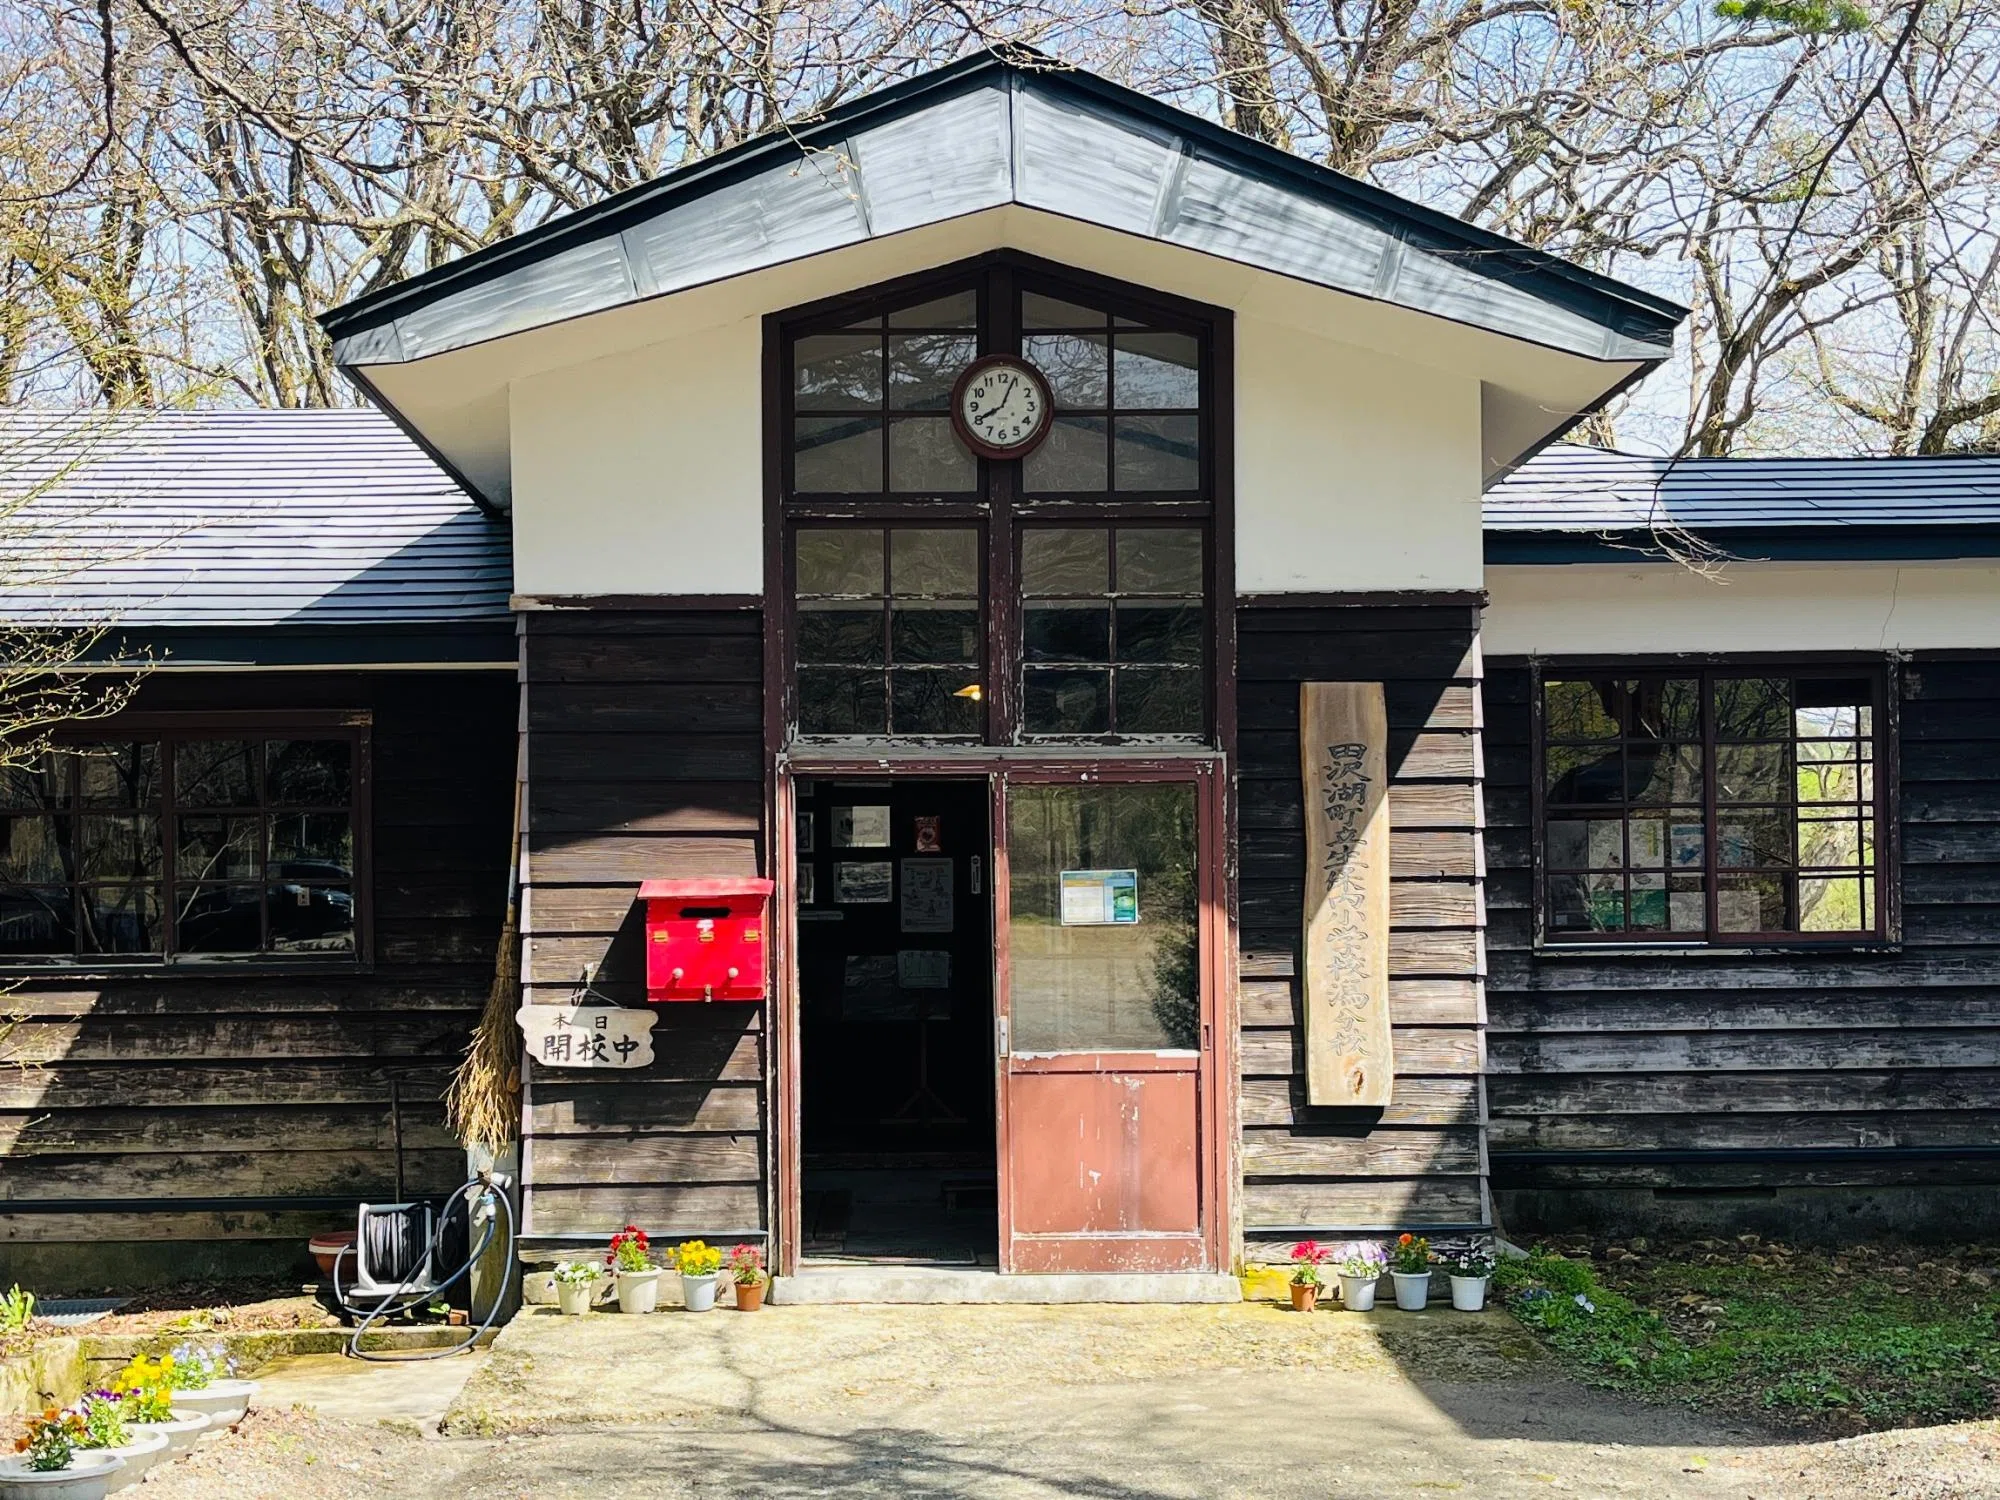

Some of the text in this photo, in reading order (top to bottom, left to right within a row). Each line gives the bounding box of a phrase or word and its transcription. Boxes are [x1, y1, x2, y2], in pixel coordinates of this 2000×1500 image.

[985, 378, 993, 387] 11
[998, 374, 1008, 383] 12
[974, 388, 984, 398] 10
[1023, 388, 1031, 398] 2
[970, 402, 978, 412] 9
[1027, 402, 1035, 412] 3
[974, 415, 983, 425] 8
[1022, 416, 1031, 425] 4
[986, 426, 993, 436] 7
[998, 430, 1007, 439] 6
[1012, 426, 1020, 436] 5
[553, 1012, 608, 1030] 本日
[543, 1033, 640, 1064] 開校中
